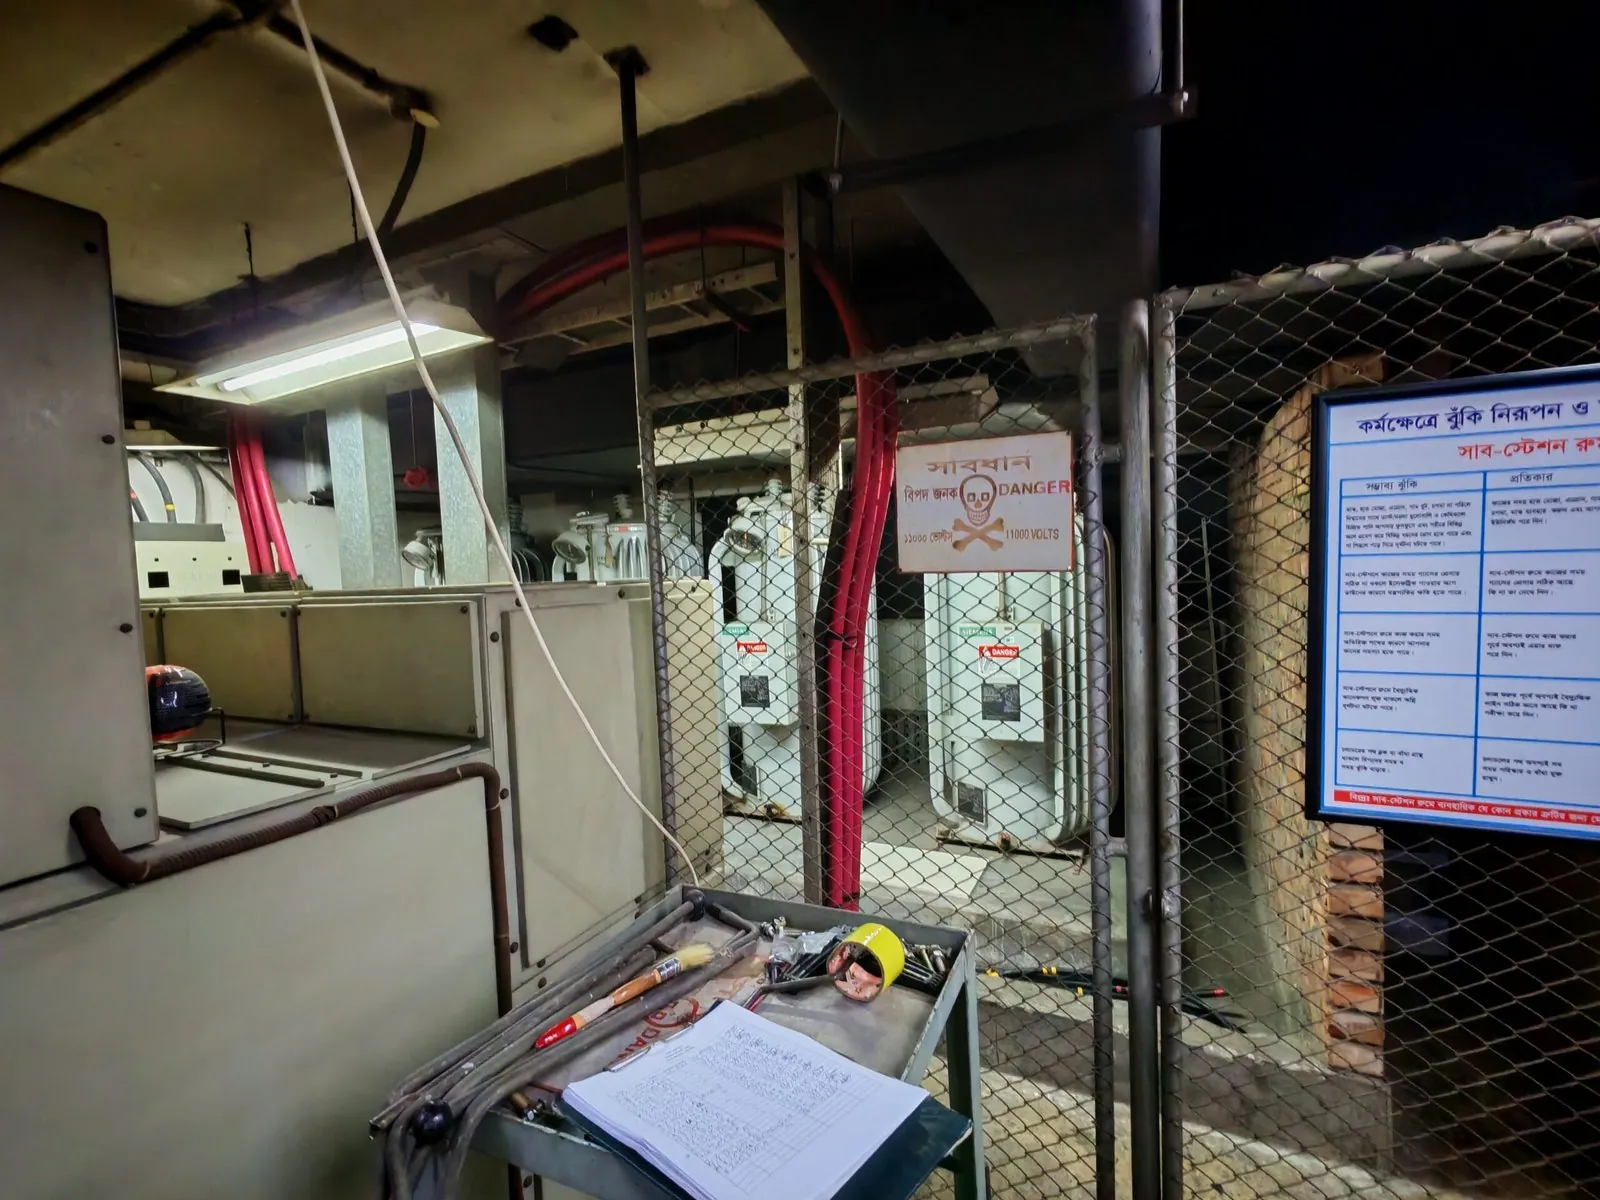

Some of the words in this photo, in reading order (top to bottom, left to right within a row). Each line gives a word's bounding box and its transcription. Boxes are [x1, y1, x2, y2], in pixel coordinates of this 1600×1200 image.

[1357, 413, 1439, 434] কর্মক্ষেত্রে
[1572, 402, 1589, 415] ও
[1457, 437, 1568, 460] সাব-স্টেশন
[926, 455, 1032, 475] সাবধান
[1509, 472, 1553, 484] প্রতিকার
[904, 485, 929, 502] বিপদ
[932, 487, 959, 501] জনক
[999, 480, 1070, 496] DANGER
[904, 533, 927, 544] ১১০০০
[1006, 529, 1029, 541] 11000
[1031, 529, 1059, 541] VOLTS
[992, 648, 1018, 656] DANGER
